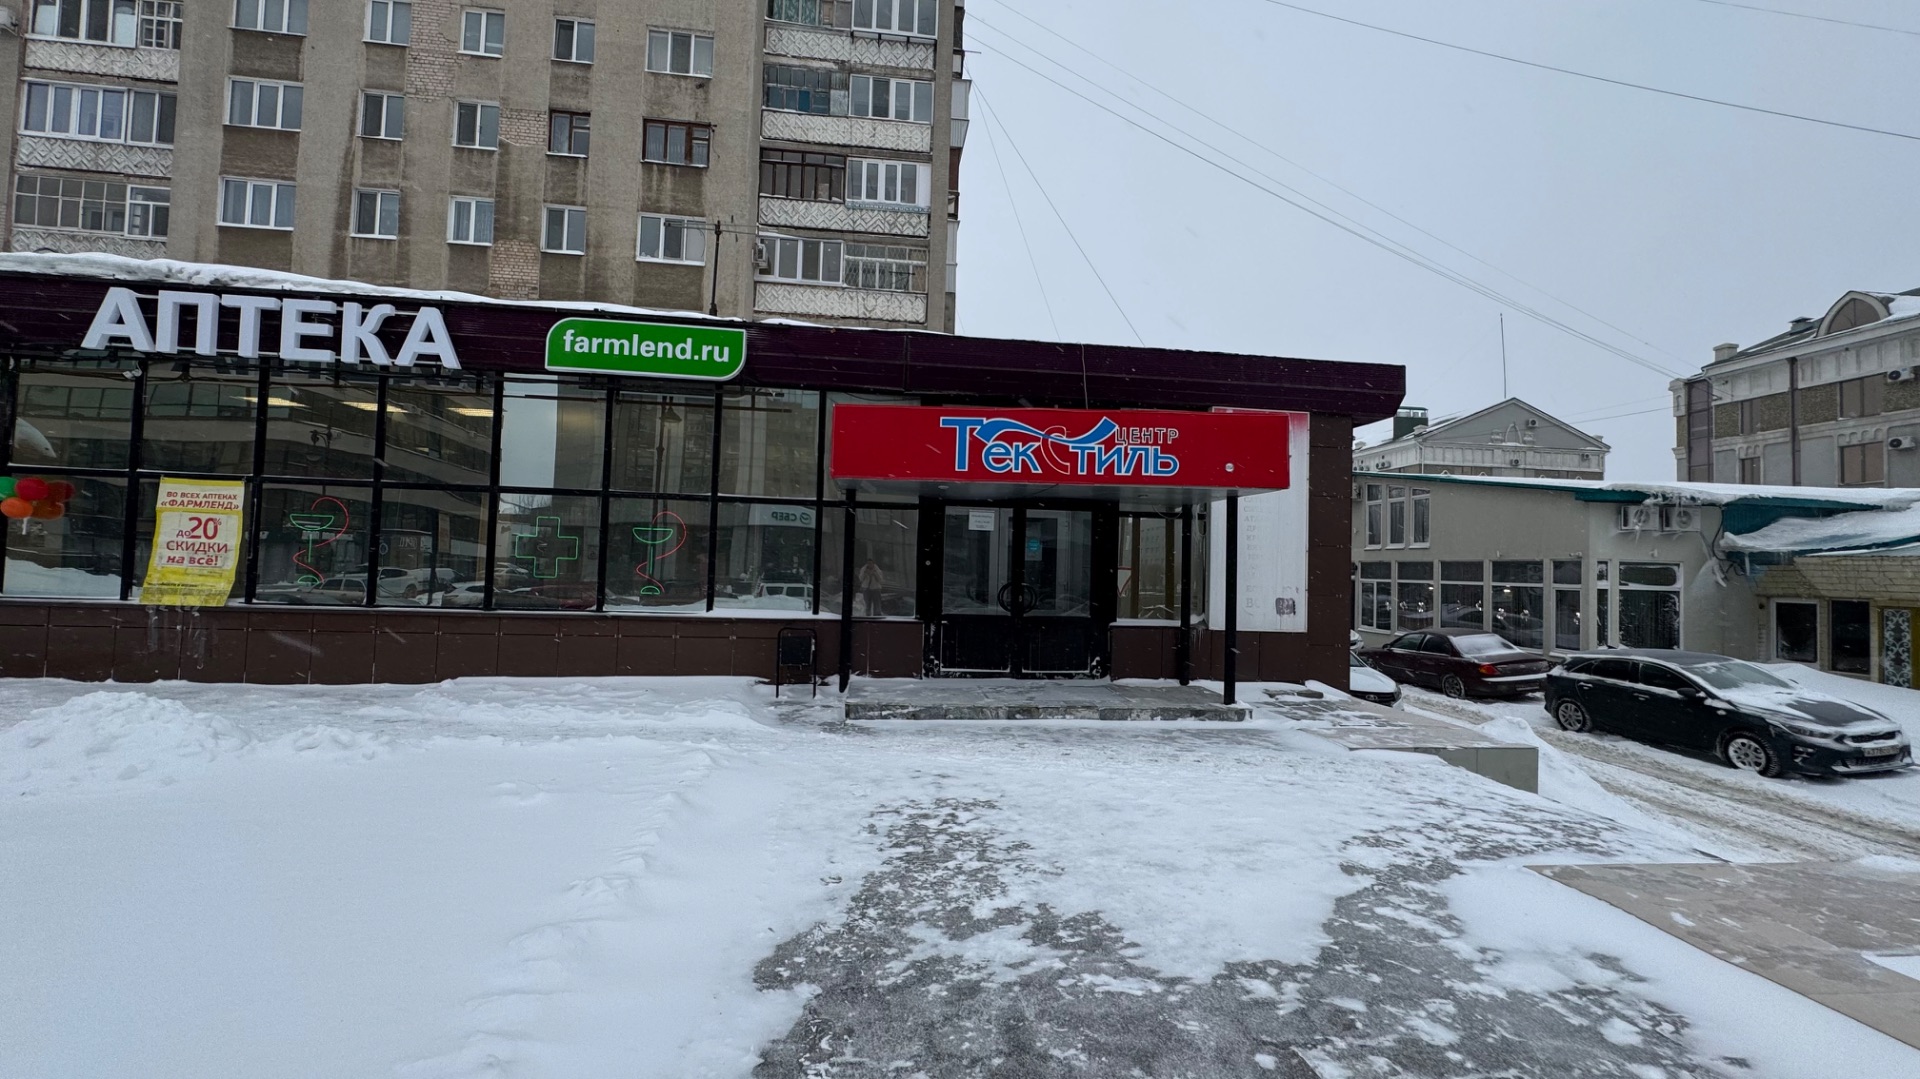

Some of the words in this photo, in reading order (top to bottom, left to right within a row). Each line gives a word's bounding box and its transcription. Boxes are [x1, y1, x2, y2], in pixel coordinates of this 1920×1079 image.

[80, 287, 462, 369] АПТЕКА
[562, 331, 730, 363] farmlend.ru
[1114, 426, 1179, 446] ЦЕНТР
[160, 499, 240, 511] «ФАРМЛЕНД»
[166, 540, 228, 555] СКИДКИ
[166, 555, 186, 565] на
